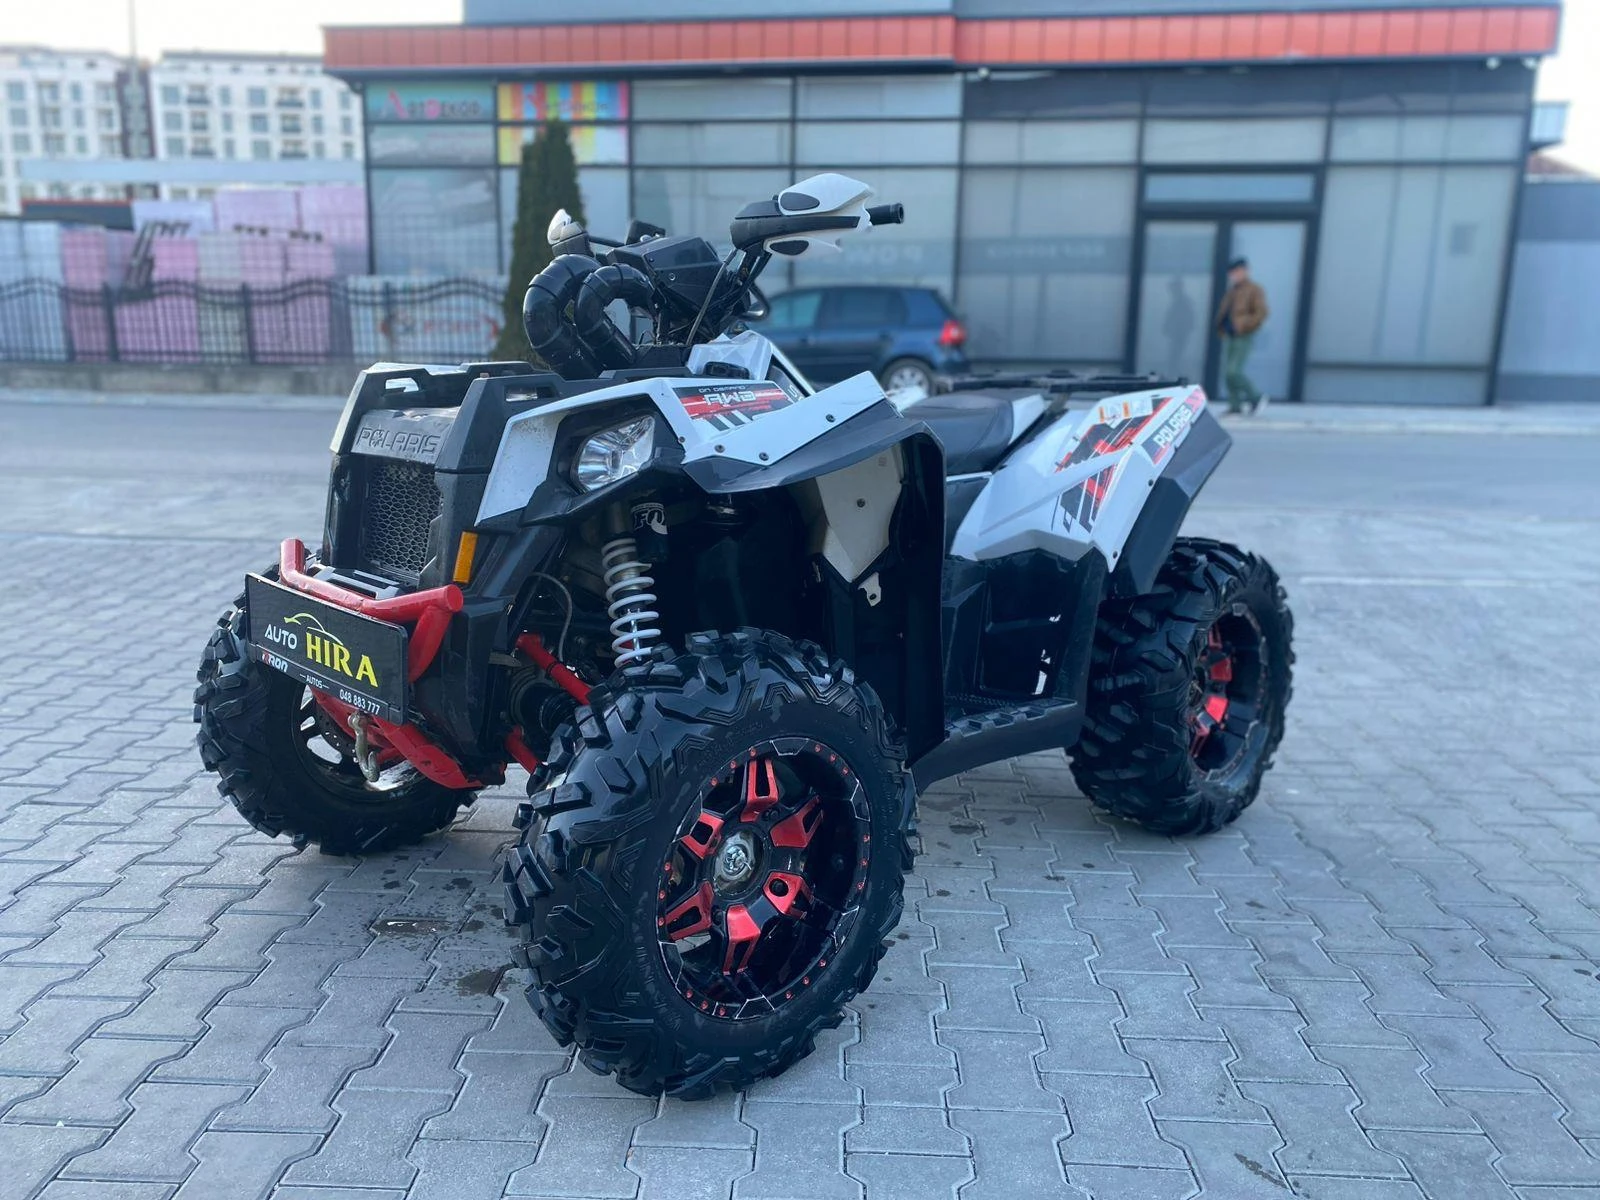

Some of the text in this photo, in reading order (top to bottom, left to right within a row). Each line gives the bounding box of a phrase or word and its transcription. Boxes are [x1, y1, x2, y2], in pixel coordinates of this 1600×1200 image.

[704, 391, 756, 405] AWD
[356, 426, 441, 454] POLARIS
[1152, 404, 1193, 449] POLARIS
[264, 624, 379, 688] AUTO HIRA
[306, 675, 323, 689] AUTOS
[339, 689, 380, 715] 048 883 777
